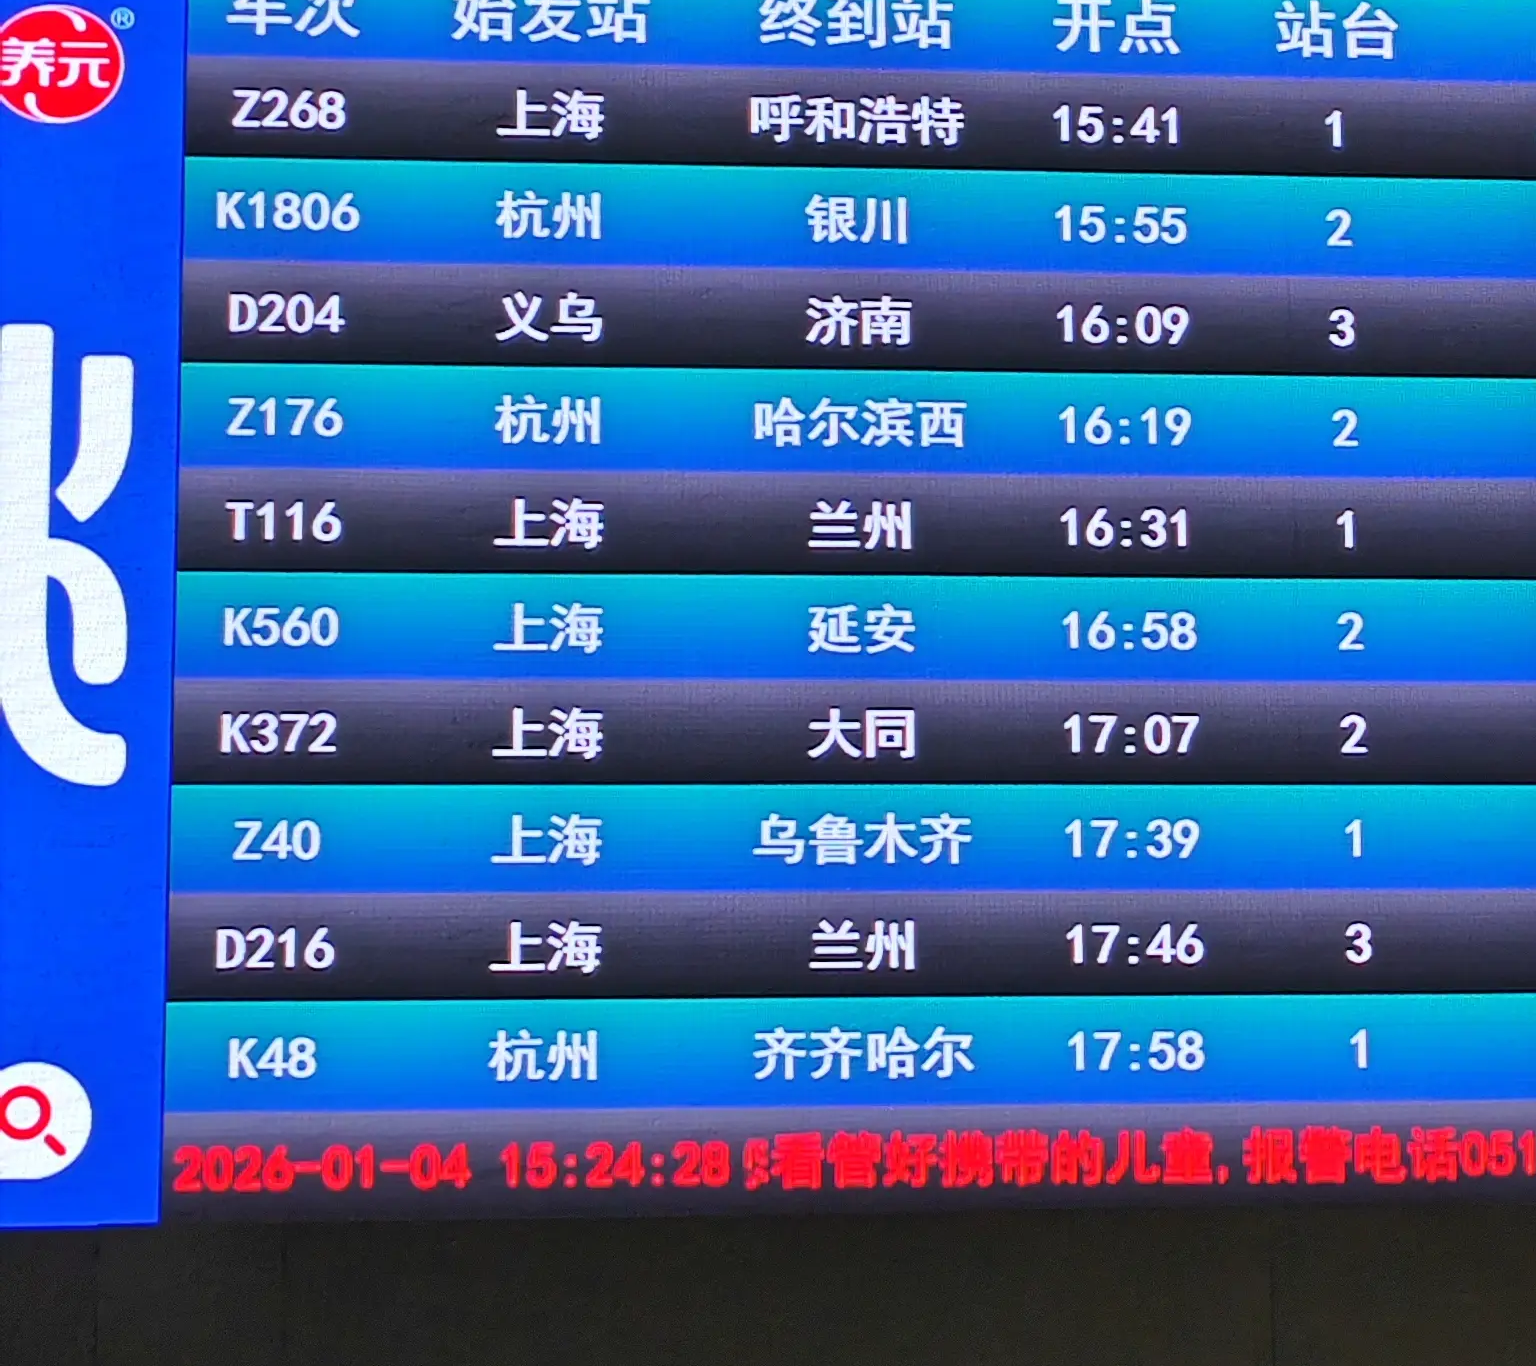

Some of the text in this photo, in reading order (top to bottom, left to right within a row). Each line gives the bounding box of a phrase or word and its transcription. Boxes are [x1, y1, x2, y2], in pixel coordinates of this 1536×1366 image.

[1273, 0, 1400, 61] 站台
[1, 36, 110, 88] 养元
[230, 88, 347, 131] Z268
[495, 88, 606, 141] 上海
[749, 93, 966, 147] 呼和浩特
[1051, 103, 1179, 145] 15:41
[1323, 108, 1344, 148] 1
[216, 190, 361, 232] K1806
[495, 189, 602, 241] 杭州
[804, 193, 908, 245] 银川
[1054, 204, 1188, 245] 15:55
[1326, 208, 1354, 247] 2
[227, 292, 347, 335] D204
[494, 290, 604, 343] 义乌
[804, 294, 914, 347] 济南
[1055, 303, 1191, 346] 16:09
[1327, 307, 1356, 348] 3
[226, 396, 344, 438] Z176
[494, 393, 602, 445] 杭州
[753, 396, 968, 449] 哈尔滨西
[1058, 405, 1193, 447] 16:19
[1332, 408, 1360, 448] 2
[223, 500, 343, 543] T116
[491, 496, 606, 551] 上海
[806, 499, 913, 551] 兰州
[1058, 506, 1188, 549] 16:31
[1335, 509, 1355, 550] 1
[223, 606, 340, 648] K560
[492, 602, 605, 655] 上海
[807, 602, 917, 655] 延安
[1062, 610, 1198, 651] 16:58
[1337, 611, 1365, 651] 2
[219, 711, 338, 754] K372
[490, 706, 605, 761] 上海
[806, 707, 917, 760] 大同
[1062, 713, 1201, 755] 17:07
[1338, 713, 1370, 755] 2
[232, 819, 322, 861] Z40
[490, 813, 603, 867] 上海
[752, 811, 973, 867] 乌鲁木齐
[1064, 818, 1201, 860] 17:39
[1345, 818, 1363, 858] 1
[214, 926, 336, 970] D216
[487, 919, 604, 975] 上海
[807, 918, 917, 972] 兰州
[1064, 922, 1206, 966] 17:46
[1343, 922, 1373, 965] 3
[228, 1036, 317, 1080] K48
[487, 1028, 598, 1082] 杭州
[753, 1025, 975, 1081] 齐齐哈尔
[1068, 1029, 1206, 1072] 17:58
[1350, 1028, 1368, 1069] 1
[172, 1141, 474, 1194] 2026-01-04
[499, 1139, 733, 1190] 15:24:28
